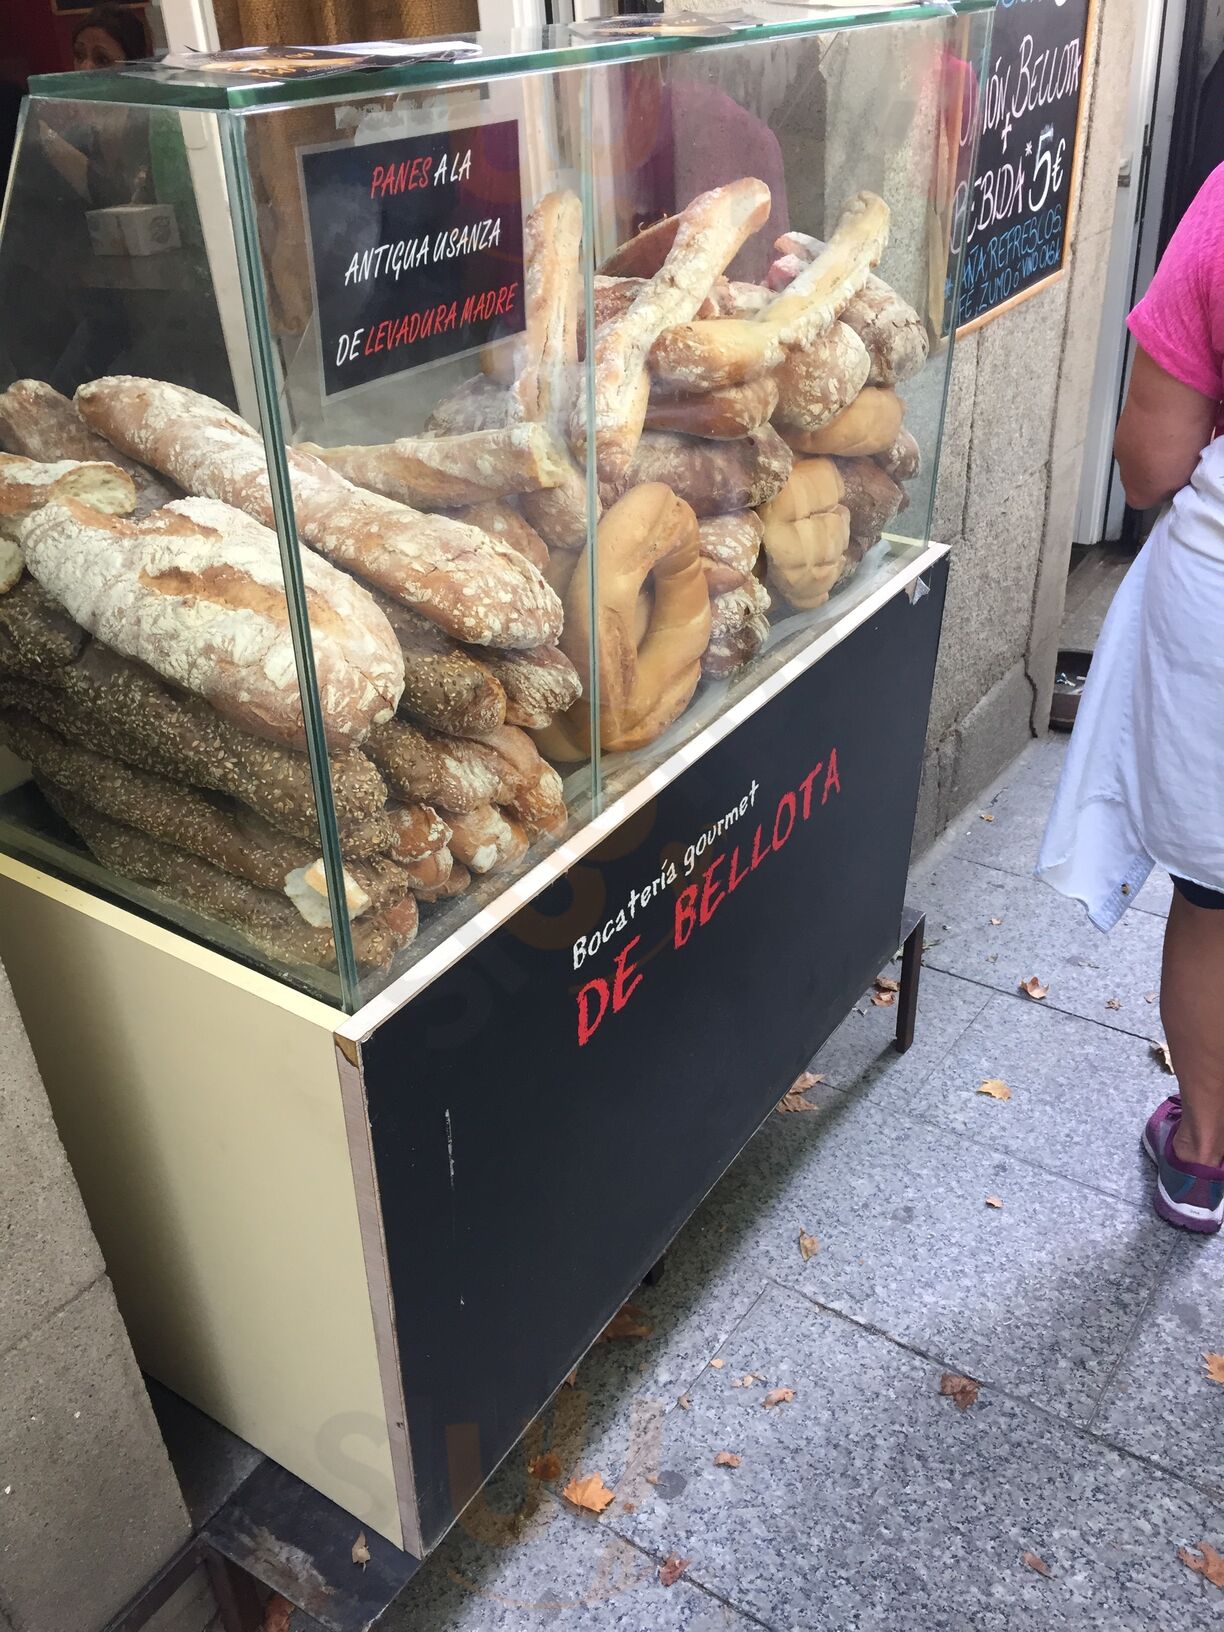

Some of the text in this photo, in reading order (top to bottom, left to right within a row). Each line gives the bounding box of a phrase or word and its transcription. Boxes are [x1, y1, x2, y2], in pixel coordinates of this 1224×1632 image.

[1011, 34, 1082, 118] BELLOTA
[370, 149, 472, 199] PANES A LA
[344, 217, 501, 287] ANTIGUA USANZA
[335, 282, 519, 366] DE LEVADURA MADRE
[572, 858, 678, 970] Bocatería
[683, 779, 760, 877] gourmet
[576, 934, 644, 1047] DE
[674, 747, 842, 950] BELLOTA
